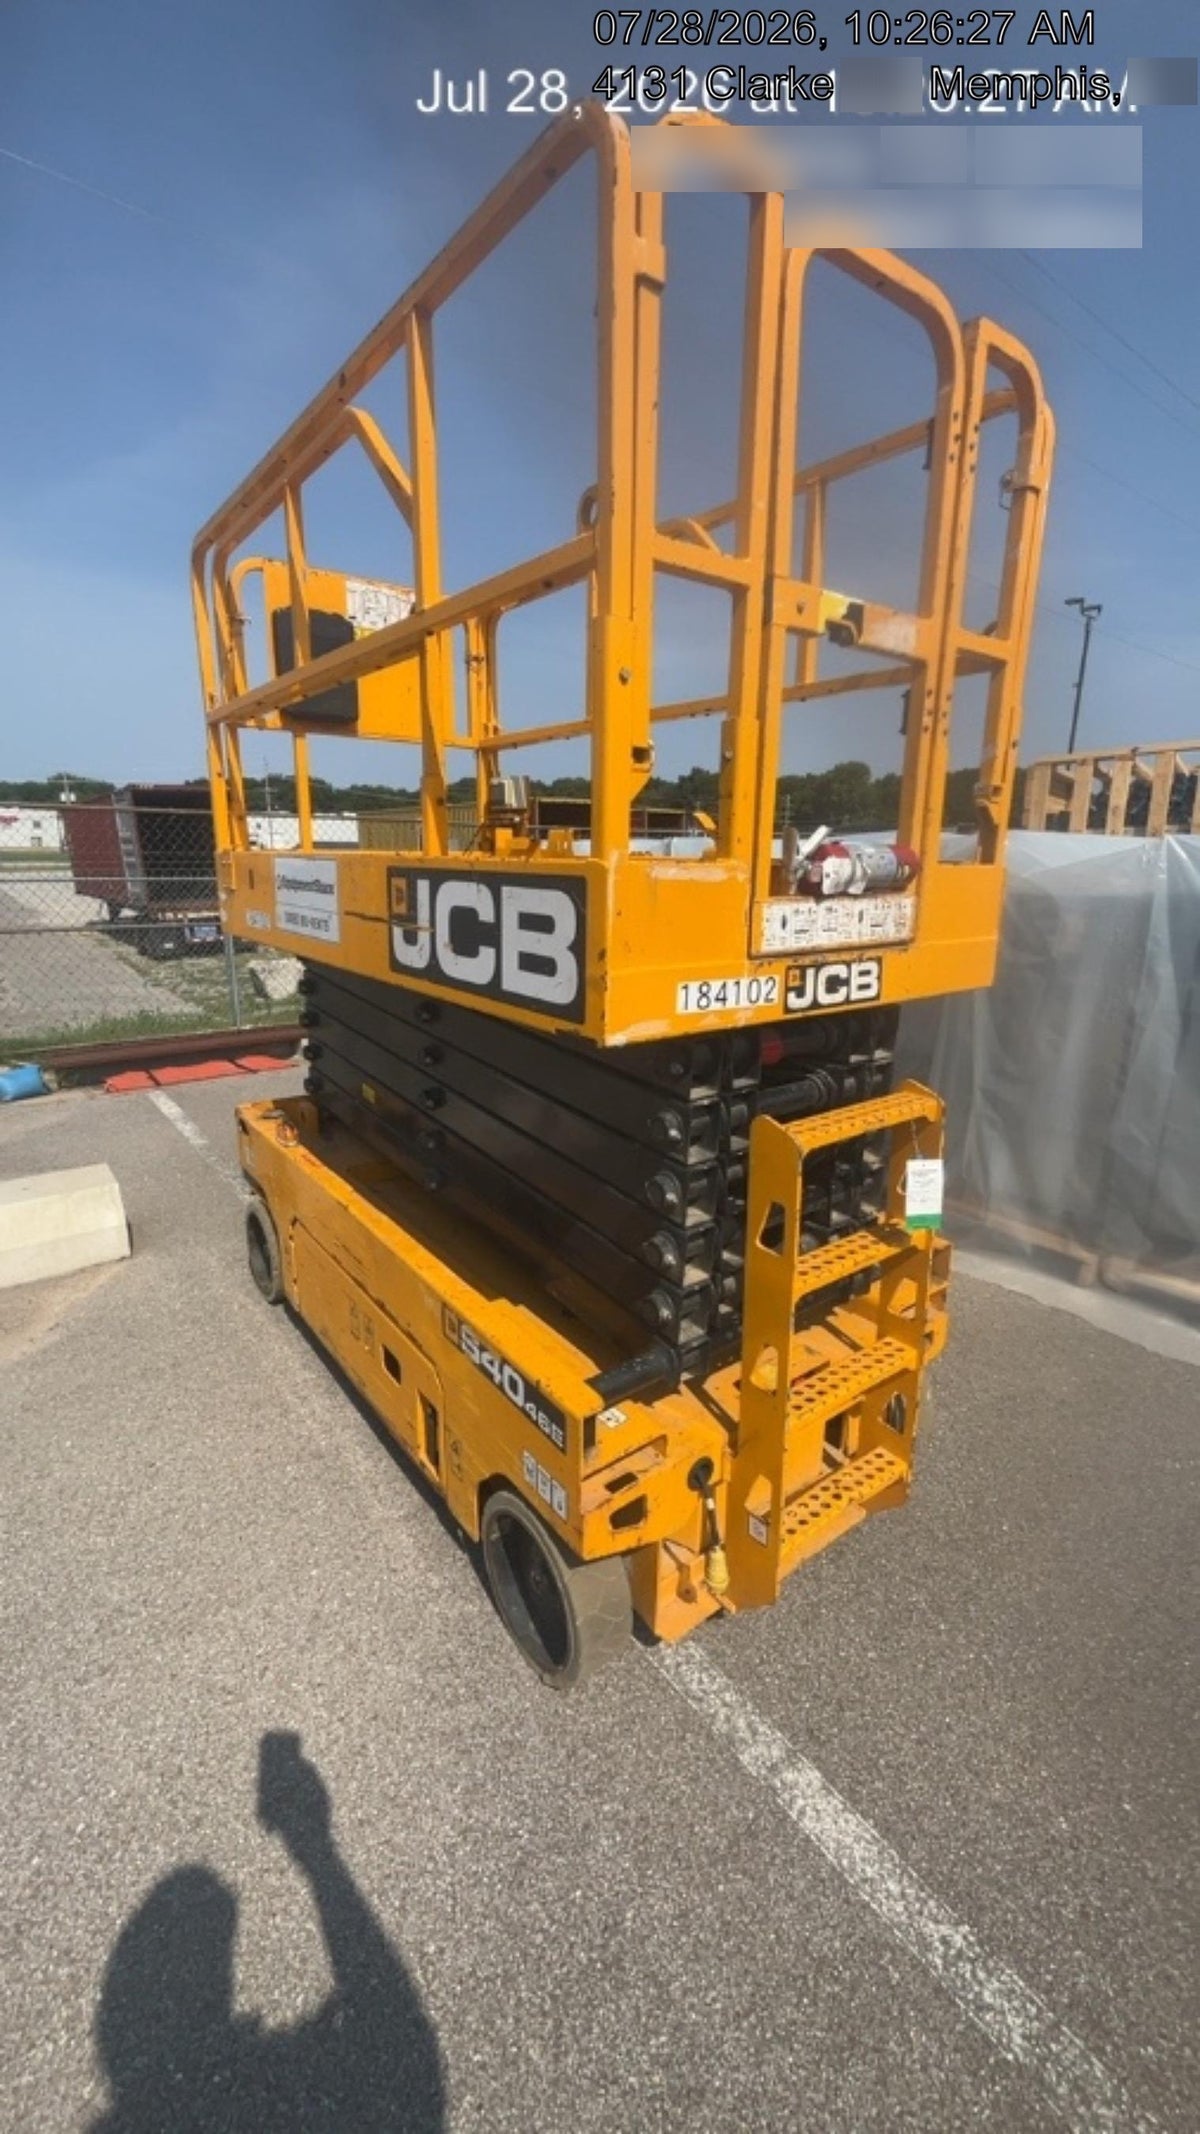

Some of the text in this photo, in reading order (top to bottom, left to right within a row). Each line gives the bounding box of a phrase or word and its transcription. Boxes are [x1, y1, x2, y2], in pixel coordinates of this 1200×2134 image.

[393, 879, 579, 1005] JCB
[681, 976, 777, 1011] 184102
[787, 961, 879, 1010] JCB
